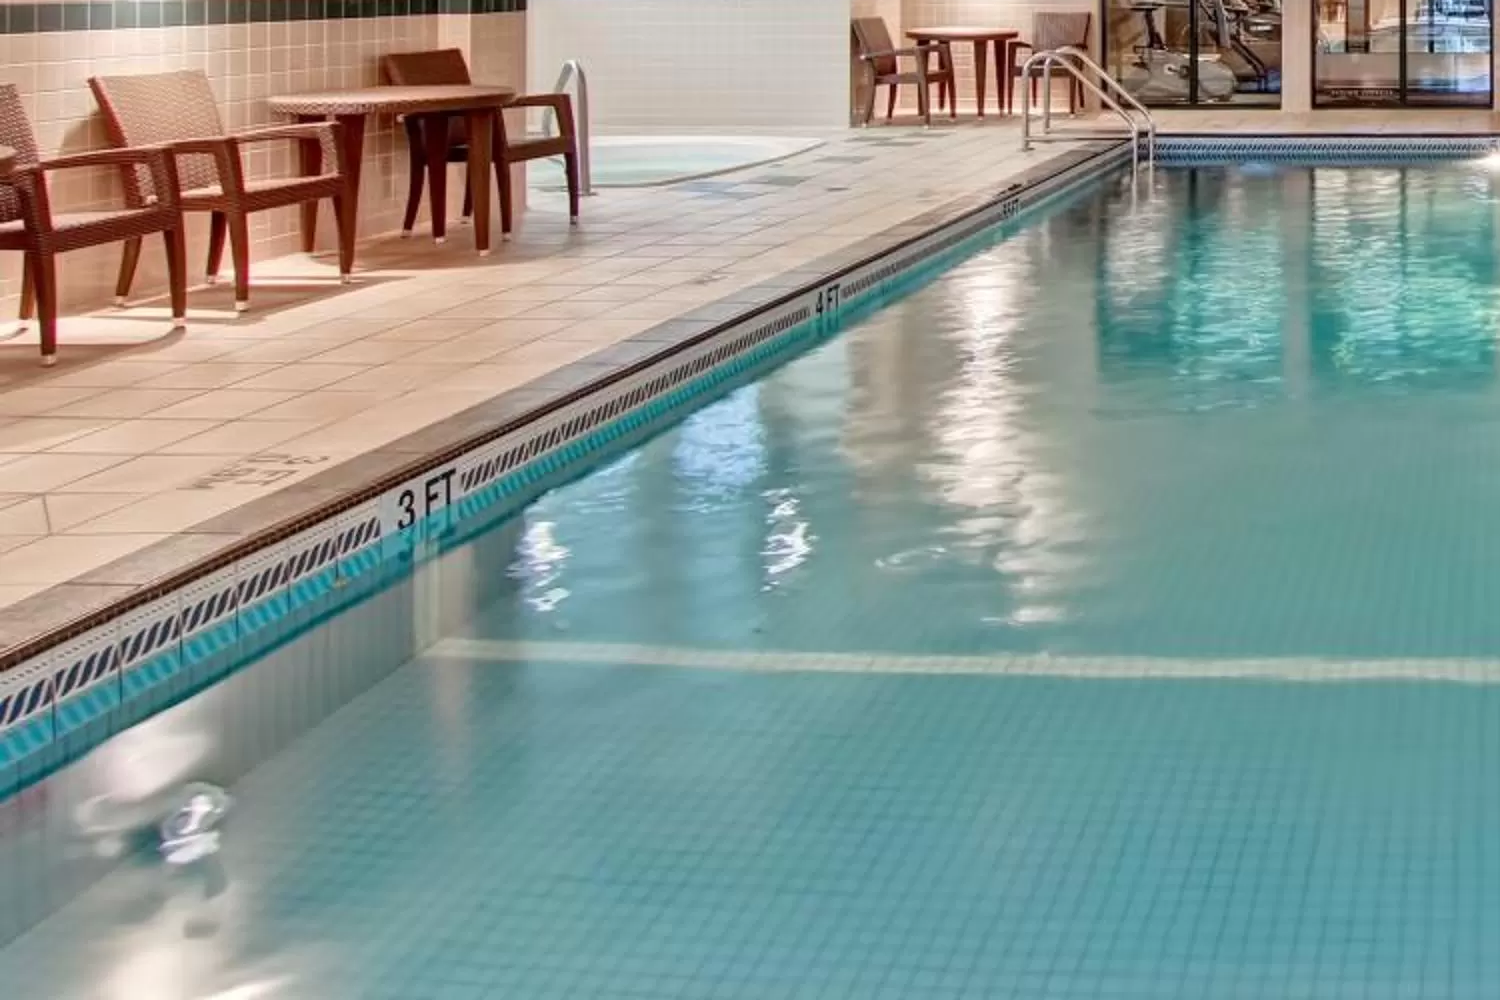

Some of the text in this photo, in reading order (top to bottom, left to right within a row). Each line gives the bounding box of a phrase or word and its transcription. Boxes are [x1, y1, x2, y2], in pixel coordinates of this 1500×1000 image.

[816, 284, 840, 314] 4 FT
[398, 468, 456, 529] 3 FT
